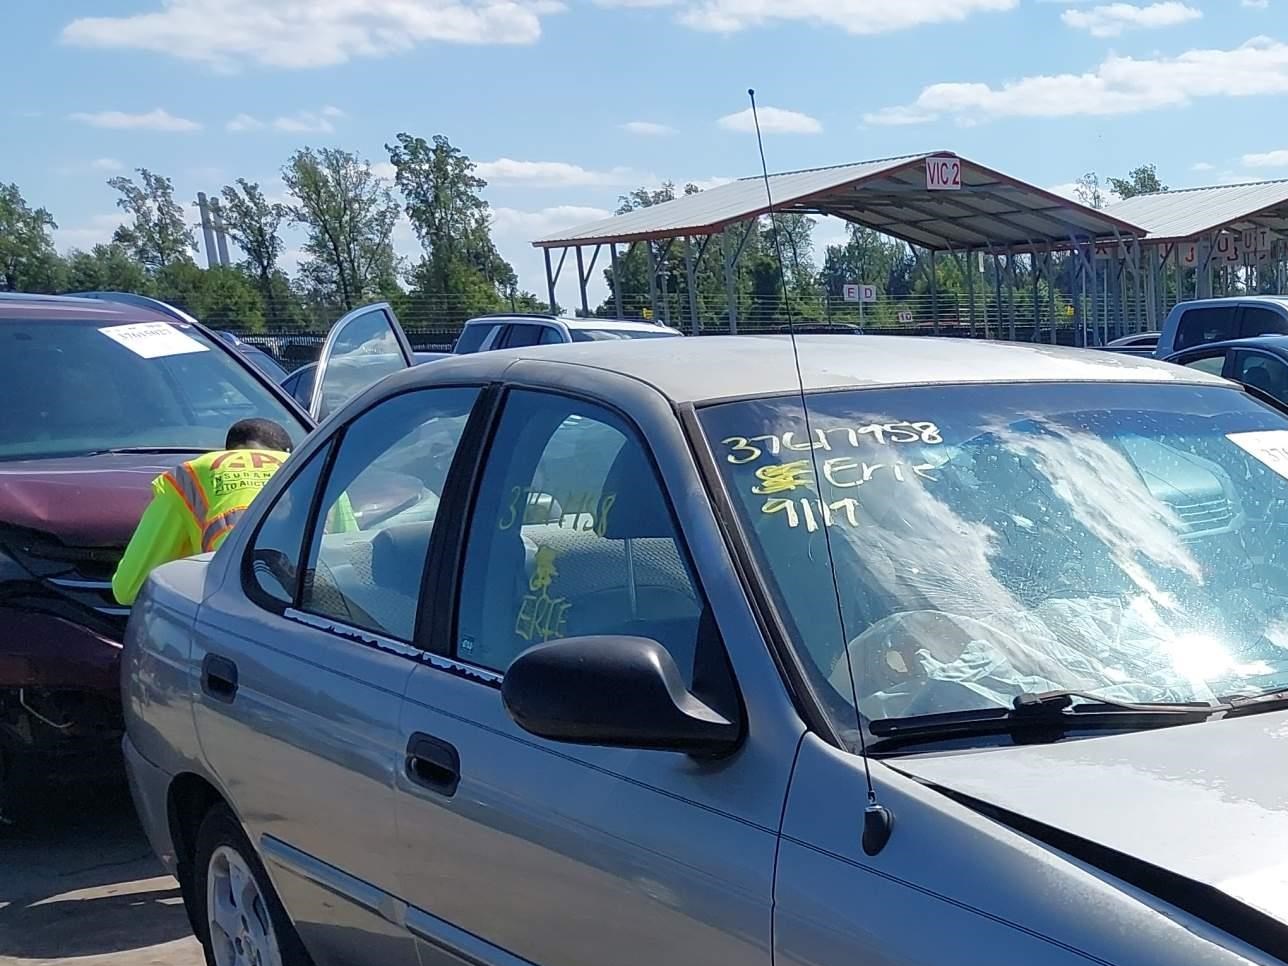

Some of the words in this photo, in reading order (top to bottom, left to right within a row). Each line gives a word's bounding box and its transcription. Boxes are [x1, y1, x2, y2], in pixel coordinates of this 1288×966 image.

[927, 162, 949, 185] VIC
[951, 162, 960, 185] 2
[864, 287, 873, 299] D
